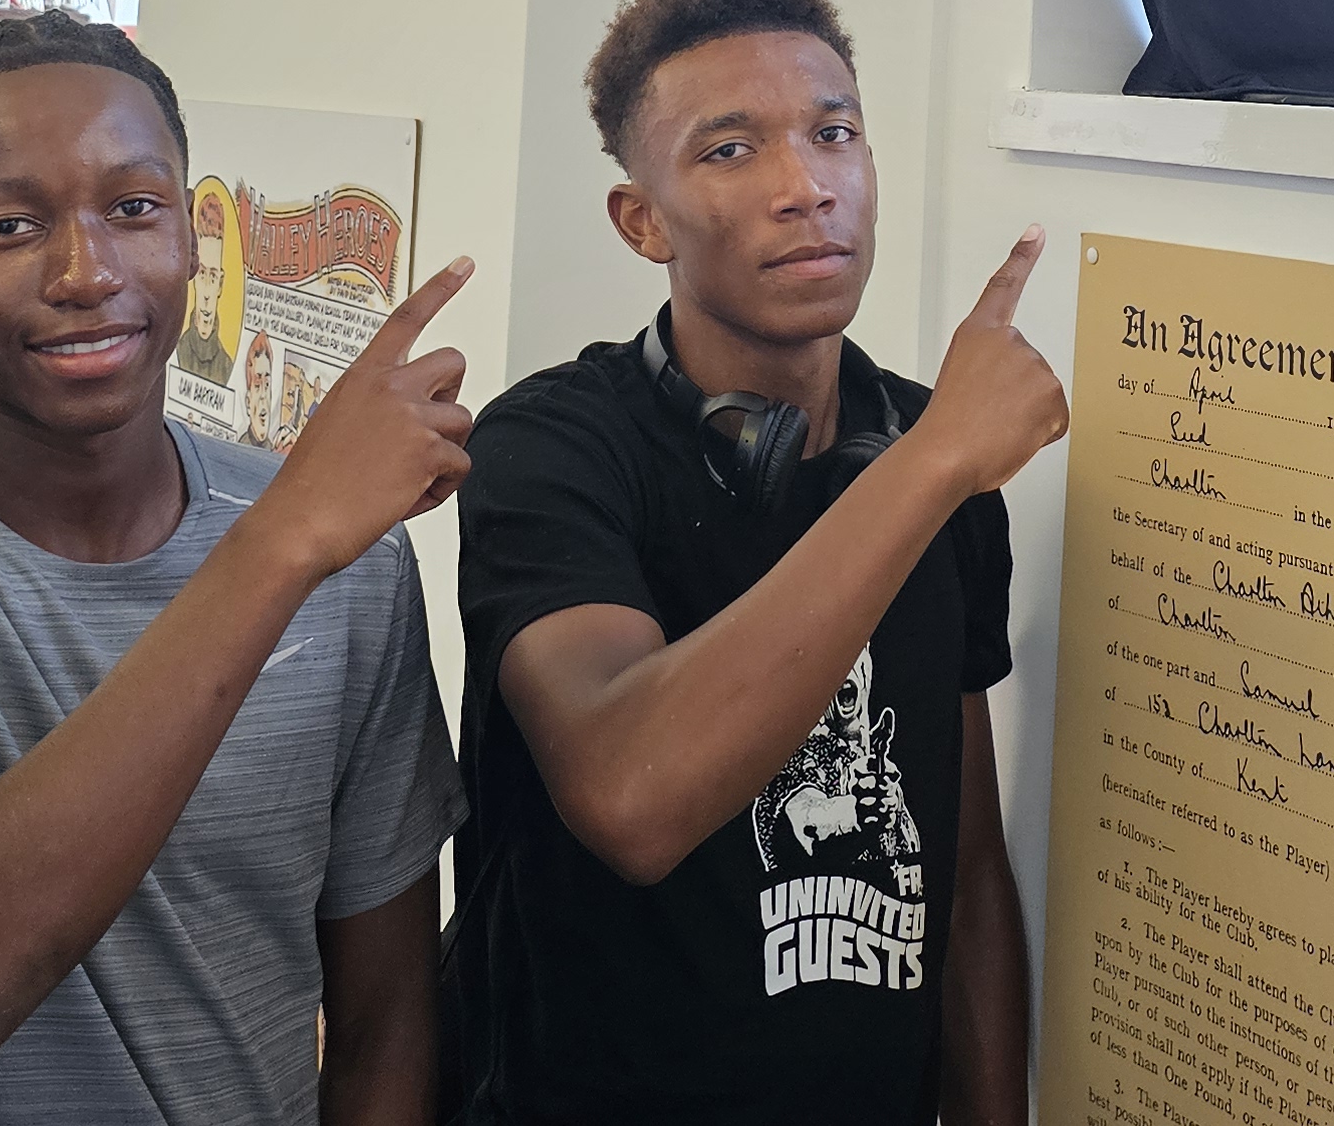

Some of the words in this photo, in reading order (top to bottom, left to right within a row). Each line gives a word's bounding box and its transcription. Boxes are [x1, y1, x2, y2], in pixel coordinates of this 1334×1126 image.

[314, 189, 391, 274] HEROES
[1121, 305, 1168, 353] An
[1117, 374, 1138, 396] day
[1143, 379, 1156, 395] of
[1113, 507, 1130, 524] the
[1134, 511, 1188, 542] Secretary
[1192, 527, 1204, 542] of
[1208, 534, 1231, 550] and
[1236, 541, 1273, 565] acting
[1278, 551, 1334, 577] pursuant
[1294, 505, 1306, 522] in
[1311, 510, 1332, 529] the
[1111, 549, 1145, 572] behalf
[1153, 562, 1165, 577] of
[1173, 567, 1192, 585] the
[1108, 595, 1120, 611] of
[760, 876, 925, 940] UNINVITED
[1097, 869, 1110, 883] of
[1114, 874, 1131, 893] his
[1135, 882, 1173, 915] ability
[1179, 901, 1196, 922] for
[1202, 912, 1221, 933] the
[1226, 924, 1259, 952] Club.
[764, 919, 923, 997] GUESTS
